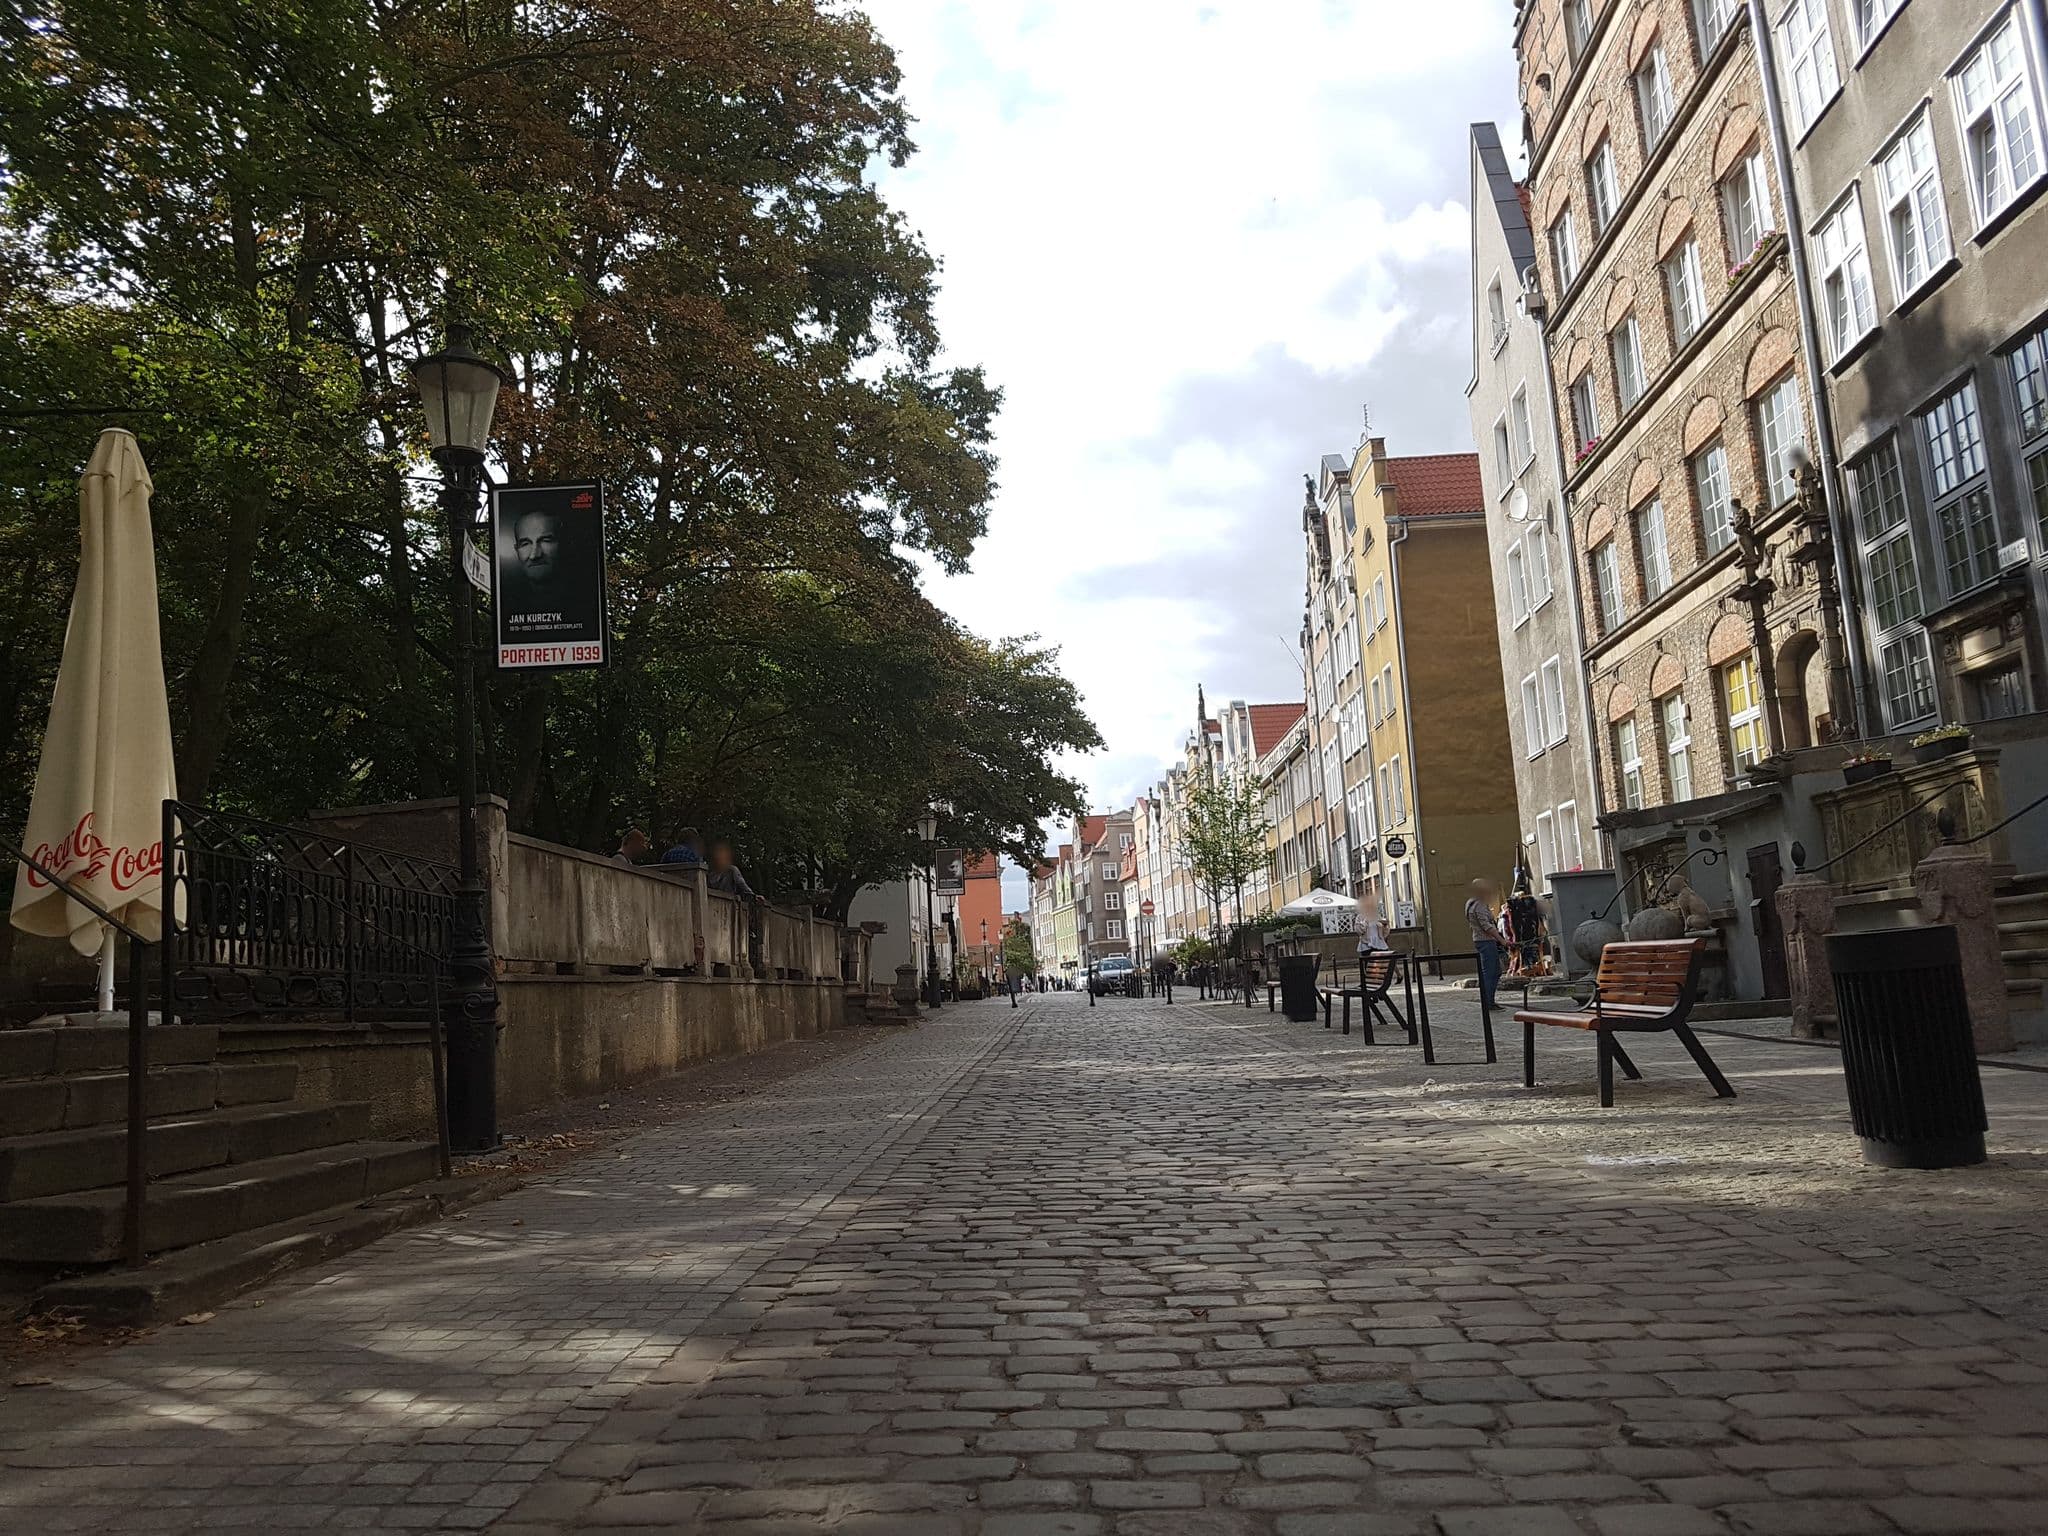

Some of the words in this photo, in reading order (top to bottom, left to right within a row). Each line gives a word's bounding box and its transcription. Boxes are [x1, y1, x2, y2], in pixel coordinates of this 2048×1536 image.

[509, 614, 525, 624] JAN
[526, 612, 562, 623] KURCZYK
[501, 647, 567, 664] PORTRETY
[572, 646, 600, 661] 1939
